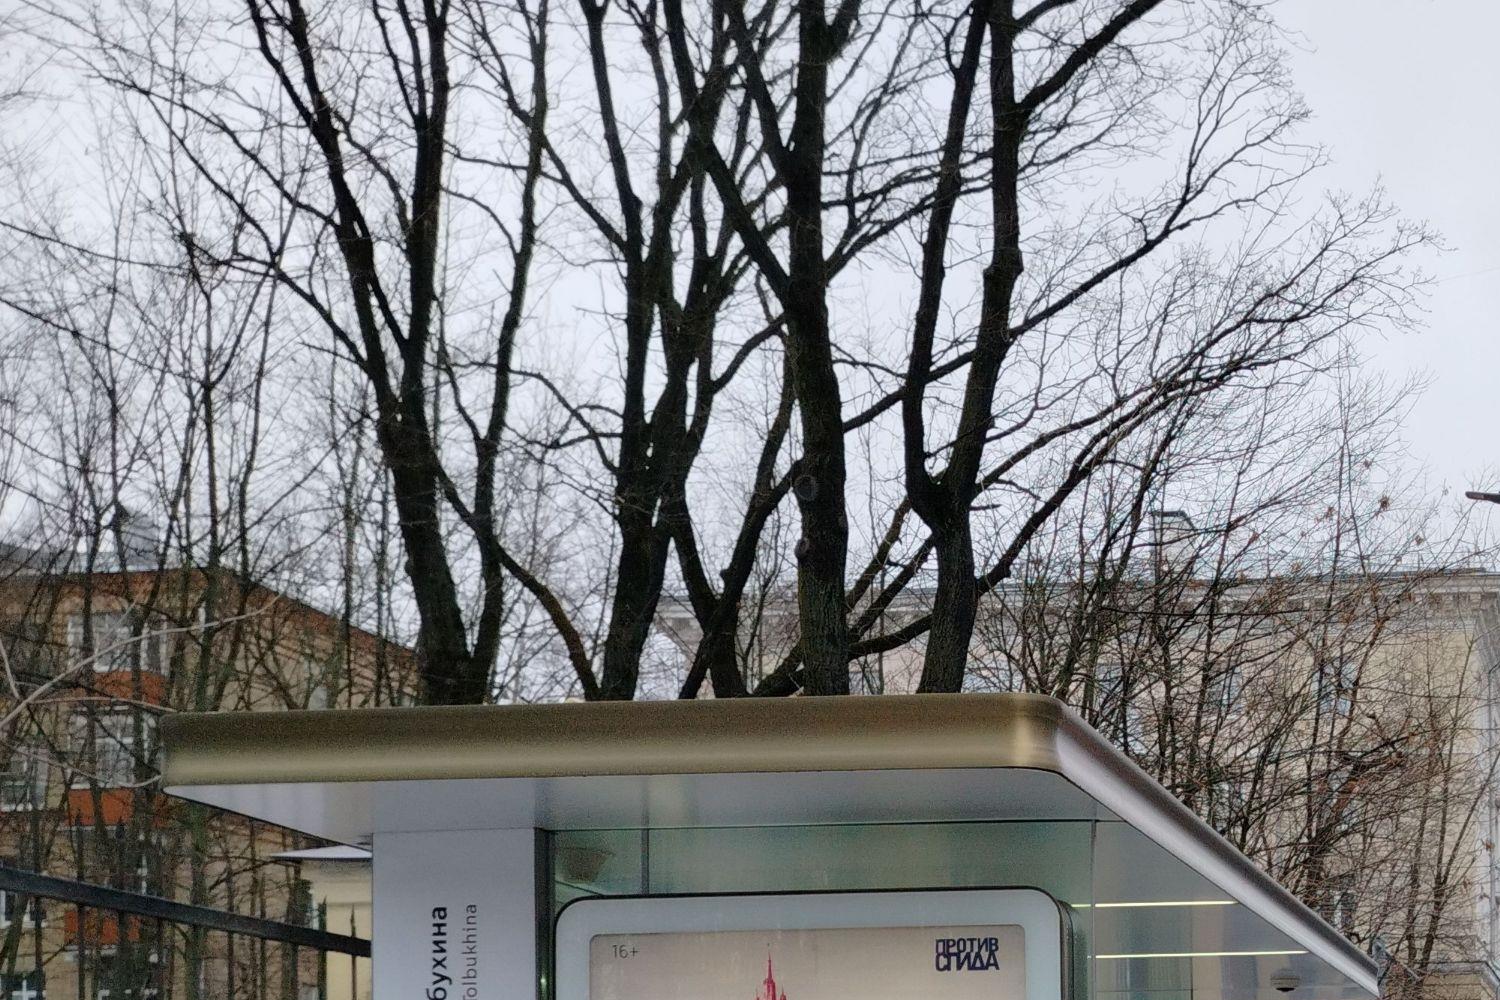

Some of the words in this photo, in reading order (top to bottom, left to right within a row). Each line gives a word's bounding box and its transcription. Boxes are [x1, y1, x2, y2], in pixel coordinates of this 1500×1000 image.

[611, 943, 639, 959] 16+
[935, 937, 999, 954] ПРОТИВ
[935, 952, 1000, 972] СПИДА
